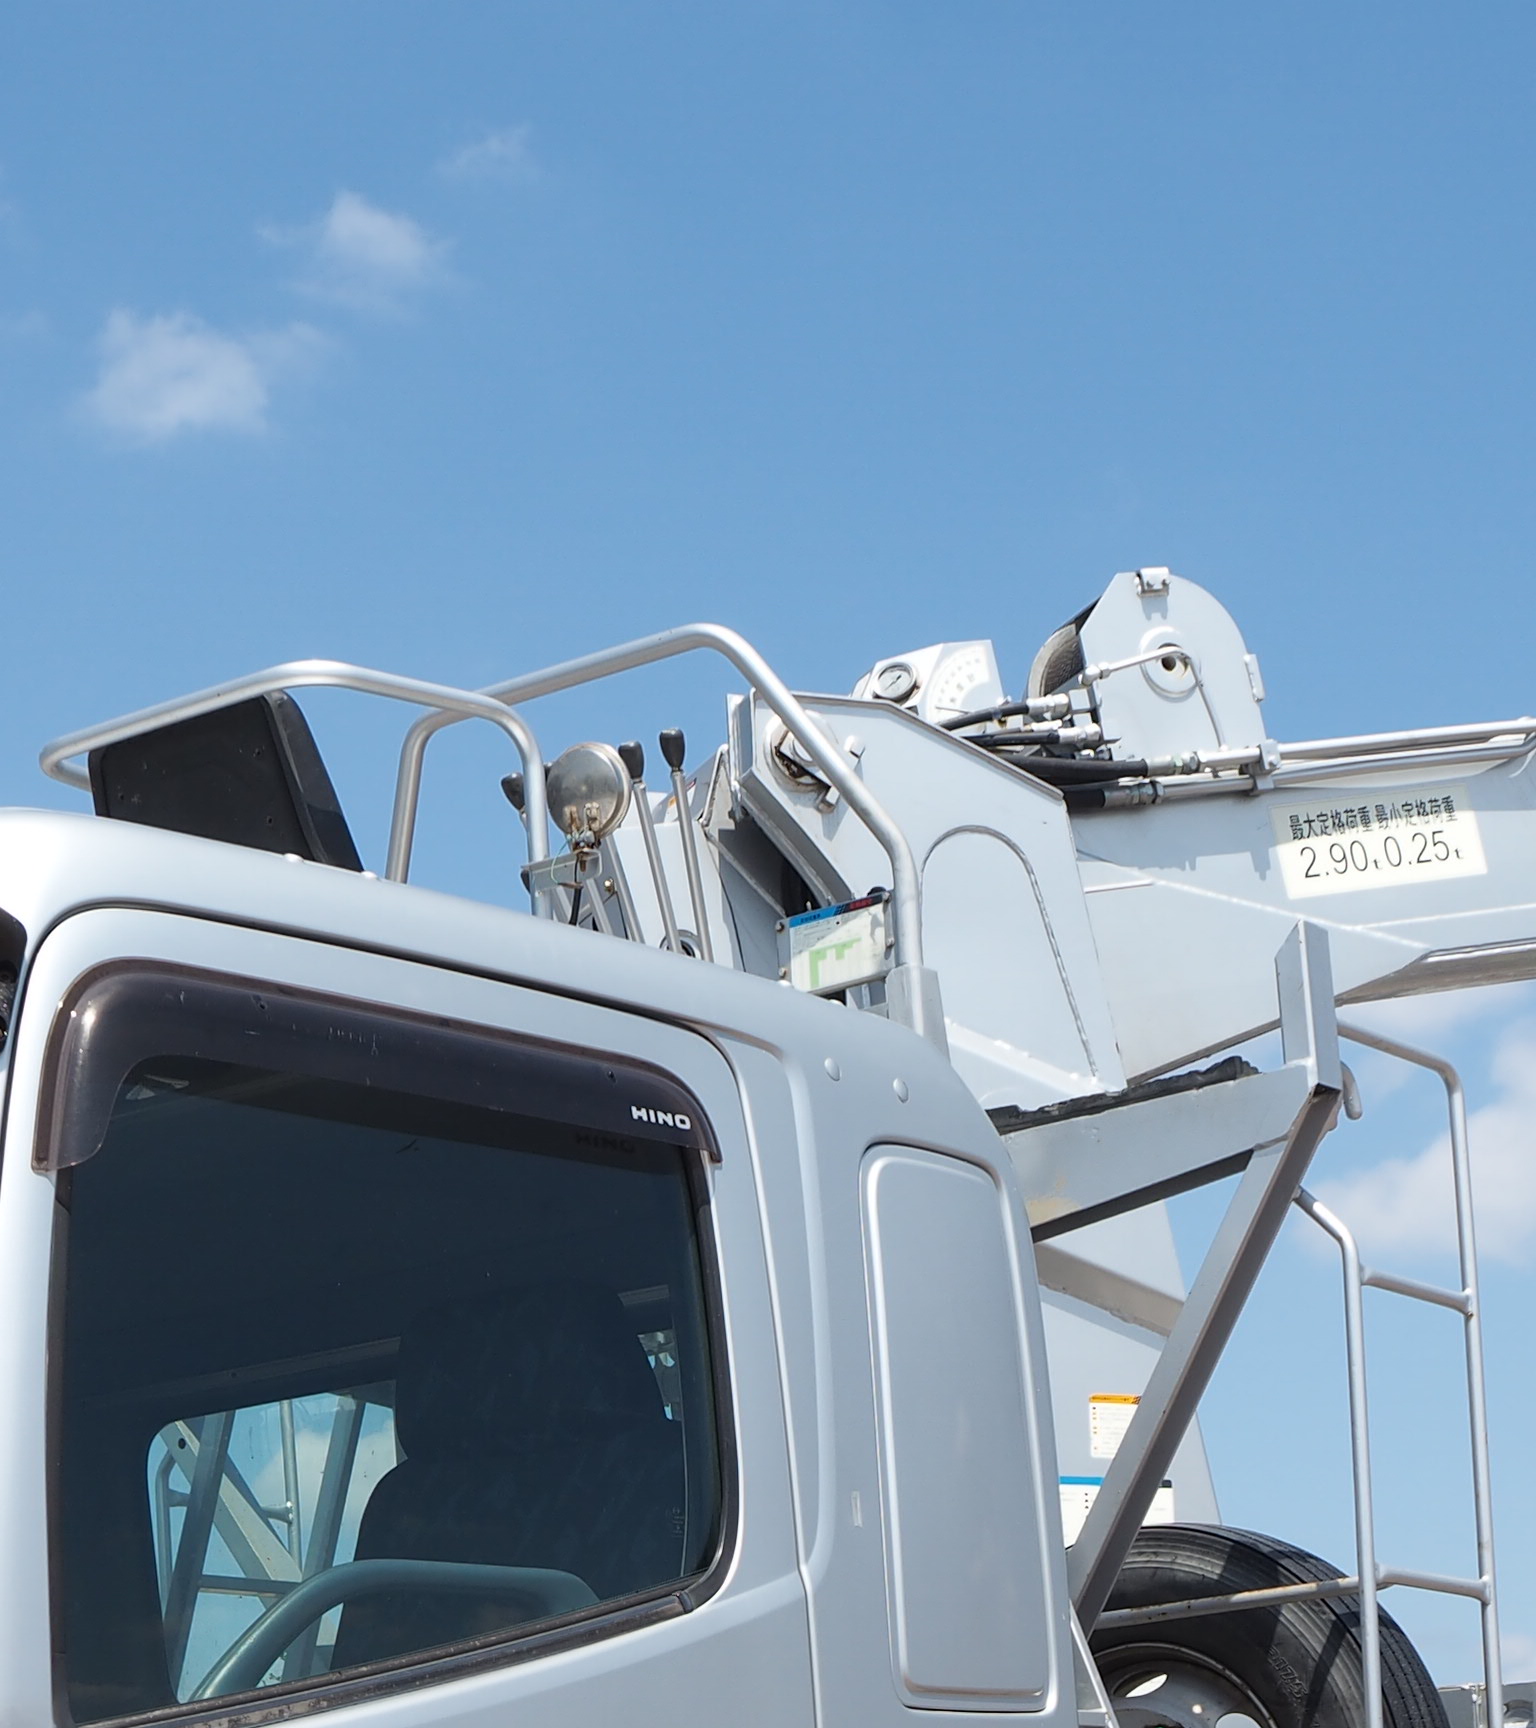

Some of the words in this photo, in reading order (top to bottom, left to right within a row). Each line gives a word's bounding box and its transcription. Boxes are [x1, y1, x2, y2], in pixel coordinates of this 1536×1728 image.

[1289, 806, 1373, 841] 最大定格荷重
[630, 1105, 693, 1130] HINO
